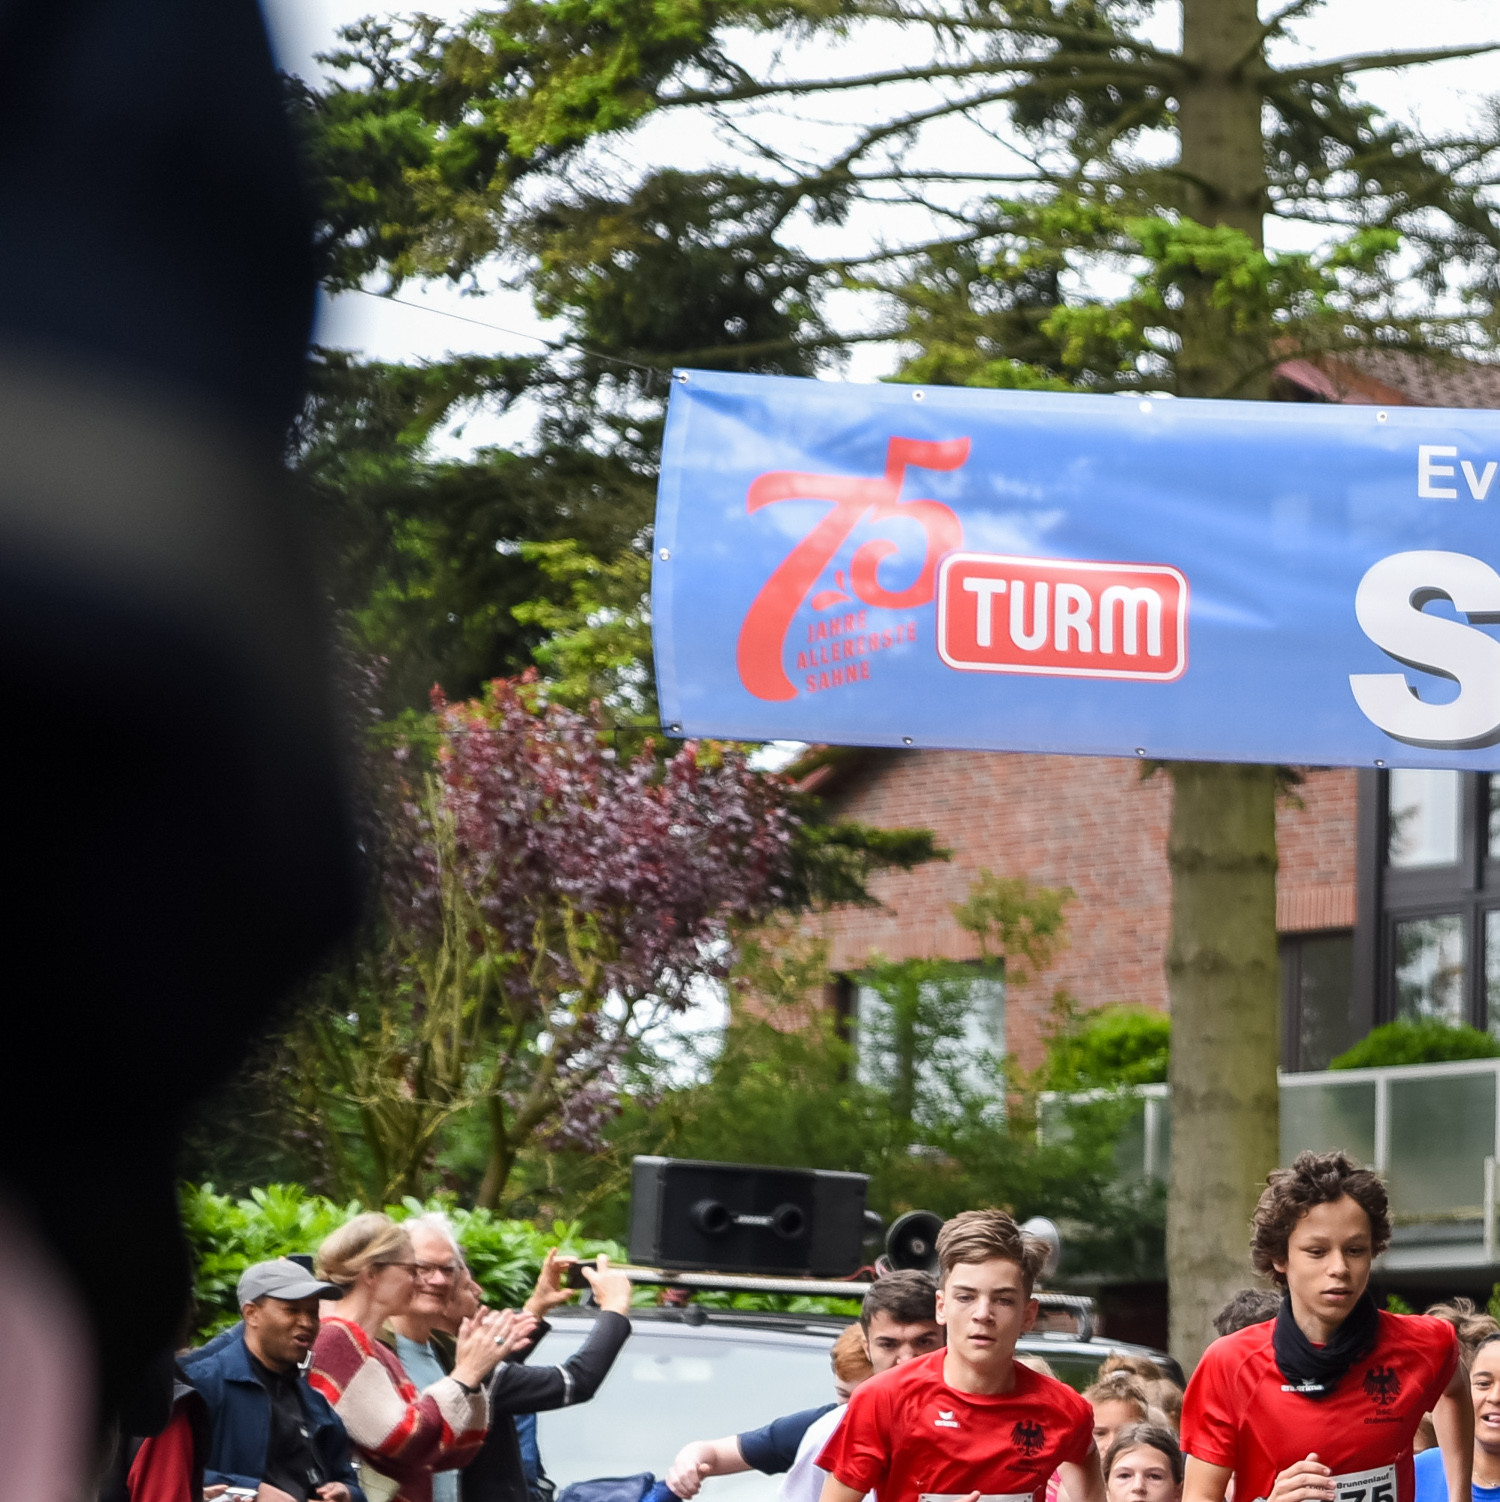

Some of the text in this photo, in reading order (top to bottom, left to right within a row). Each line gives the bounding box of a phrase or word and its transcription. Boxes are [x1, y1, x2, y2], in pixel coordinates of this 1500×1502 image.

[736, 436, 971, 701] 75
[806, 610, 868, 642] JAHRE
[963, 577, 1162, 657] TURM
[797, 622, 919, 671] ALLERERSTE
[806, 660, 871, 694] SAHNE
[1336, 1472, 1390, 1489] Brunnenlauf
